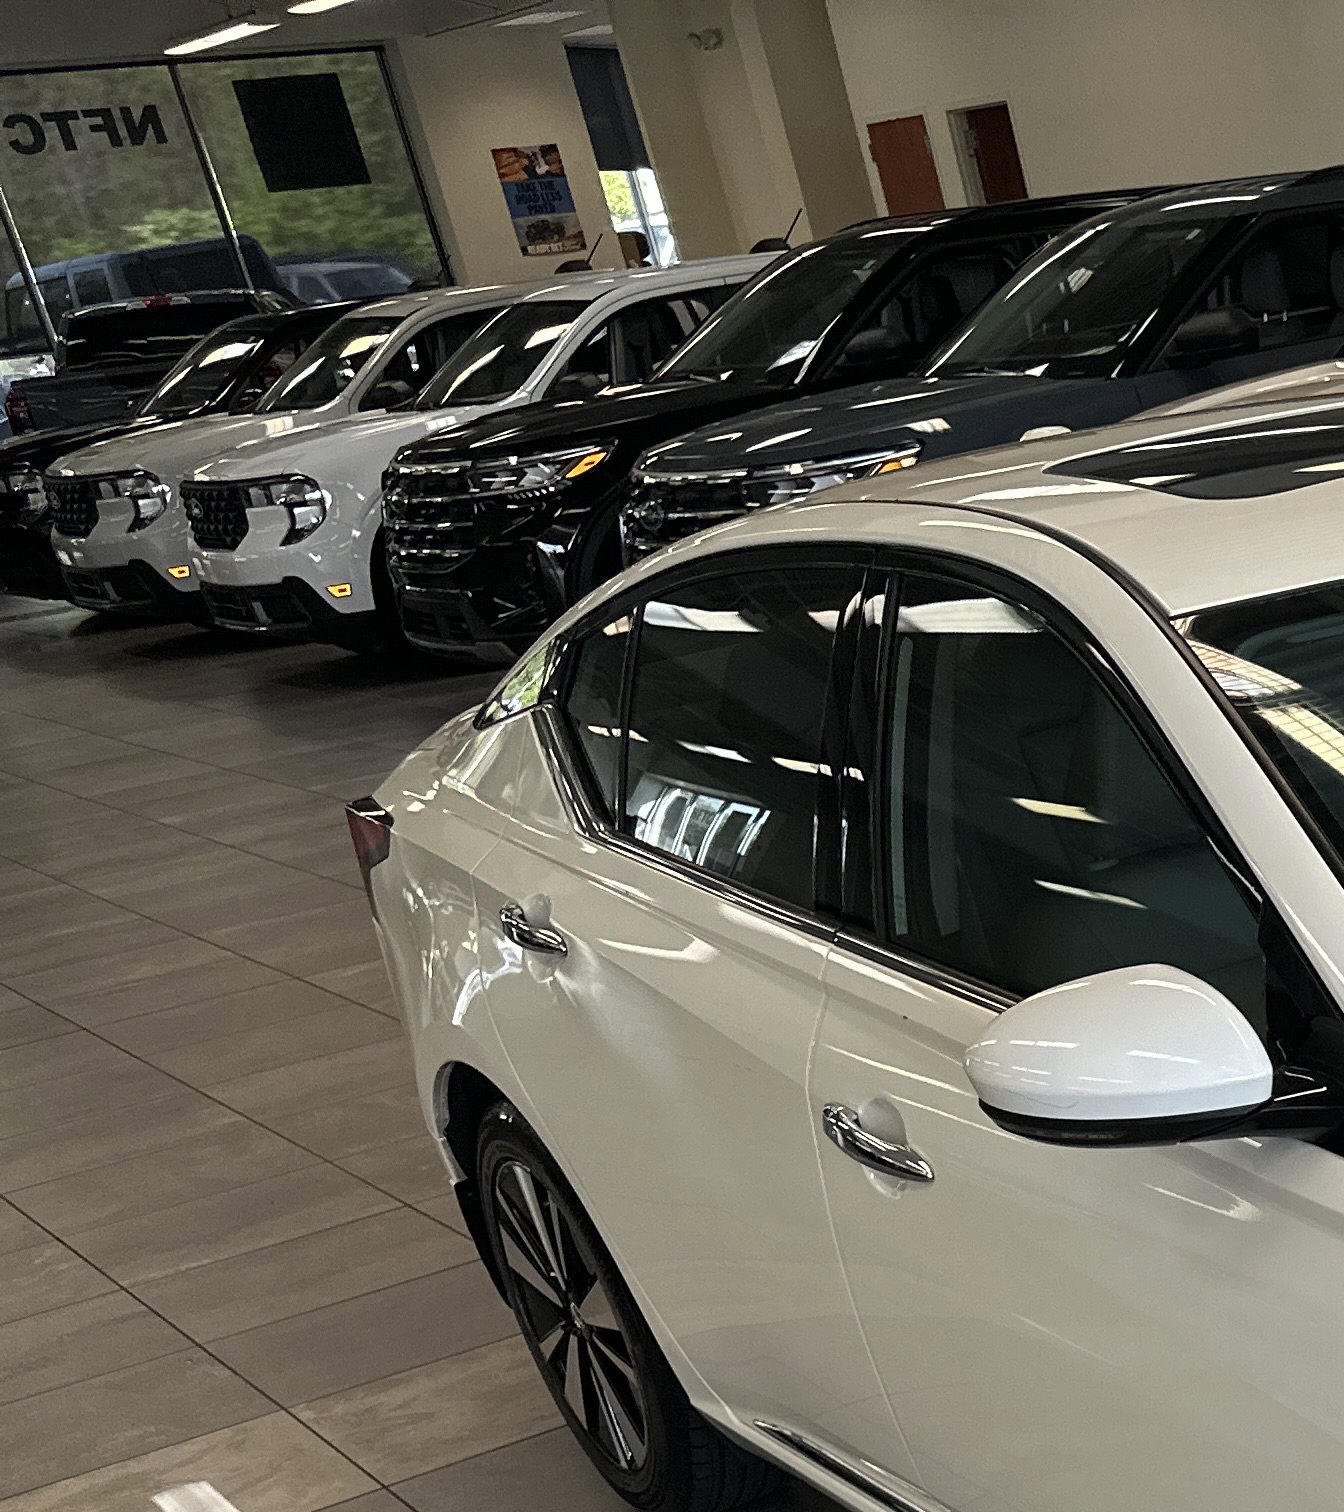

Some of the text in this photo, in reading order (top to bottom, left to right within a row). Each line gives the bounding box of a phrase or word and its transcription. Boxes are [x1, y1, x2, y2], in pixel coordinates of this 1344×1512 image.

[515, 180, 556, 194] TAKE THE
[515, 190, 562, 205] ROAD LESS
